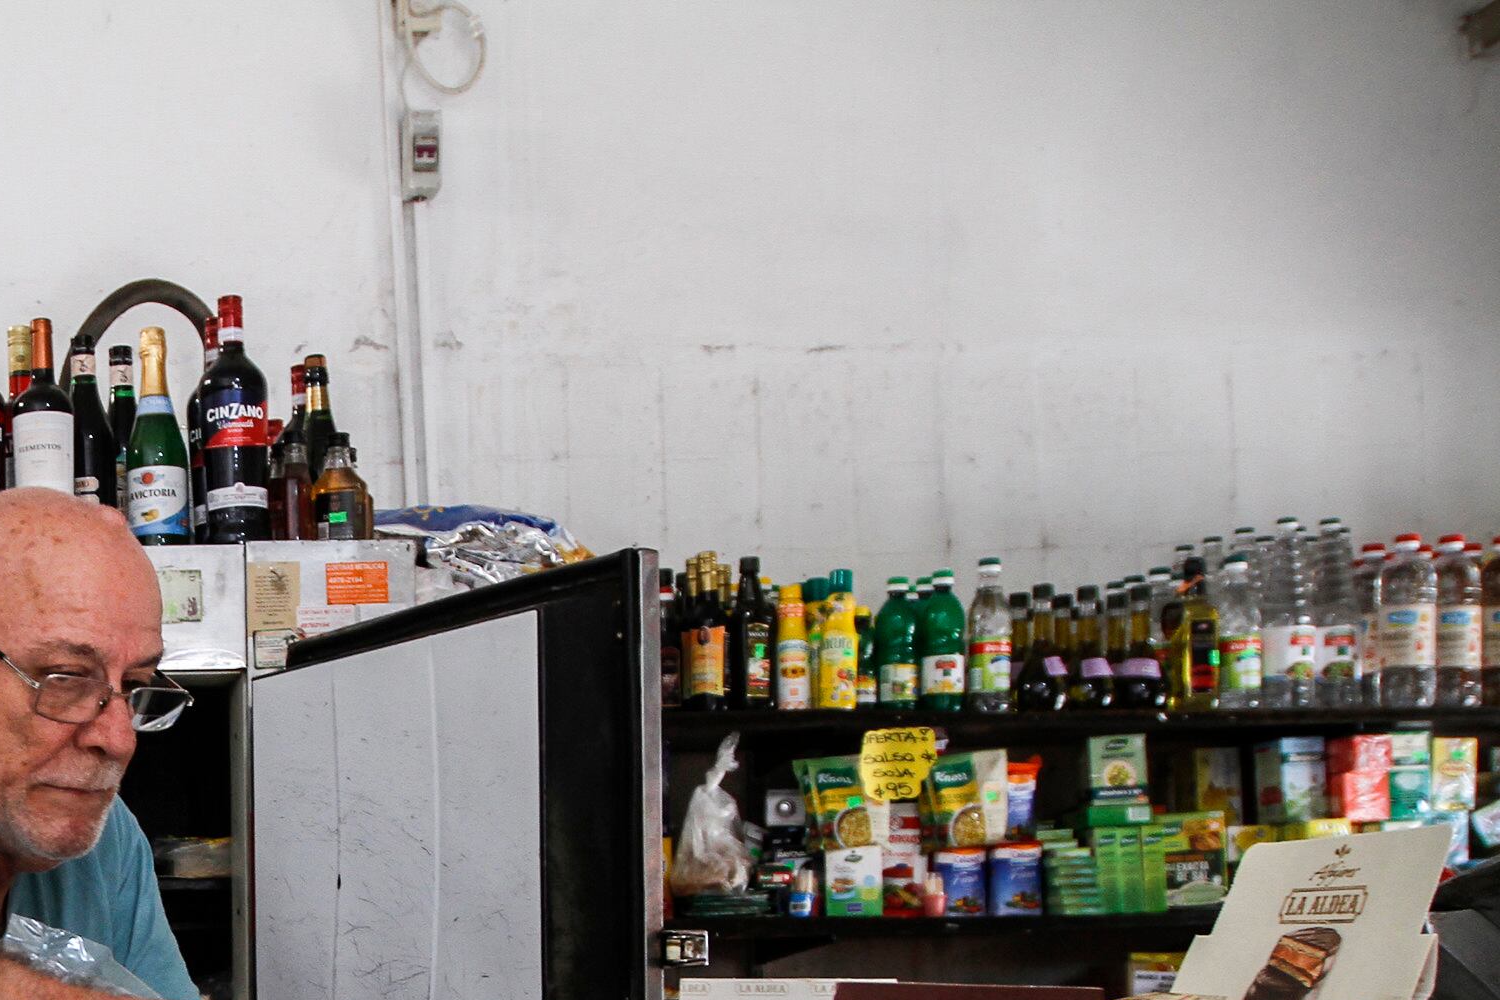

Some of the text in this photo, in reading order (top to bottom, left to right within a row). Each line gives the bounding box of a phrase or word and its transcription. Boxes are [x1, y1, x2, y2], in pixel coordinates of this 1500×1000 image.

[207, 403, 263, 422] CINZANO
[1285, 894, 1361, 915] LA ALDEA
[739, 985, 786, 993] LA ALDEA
